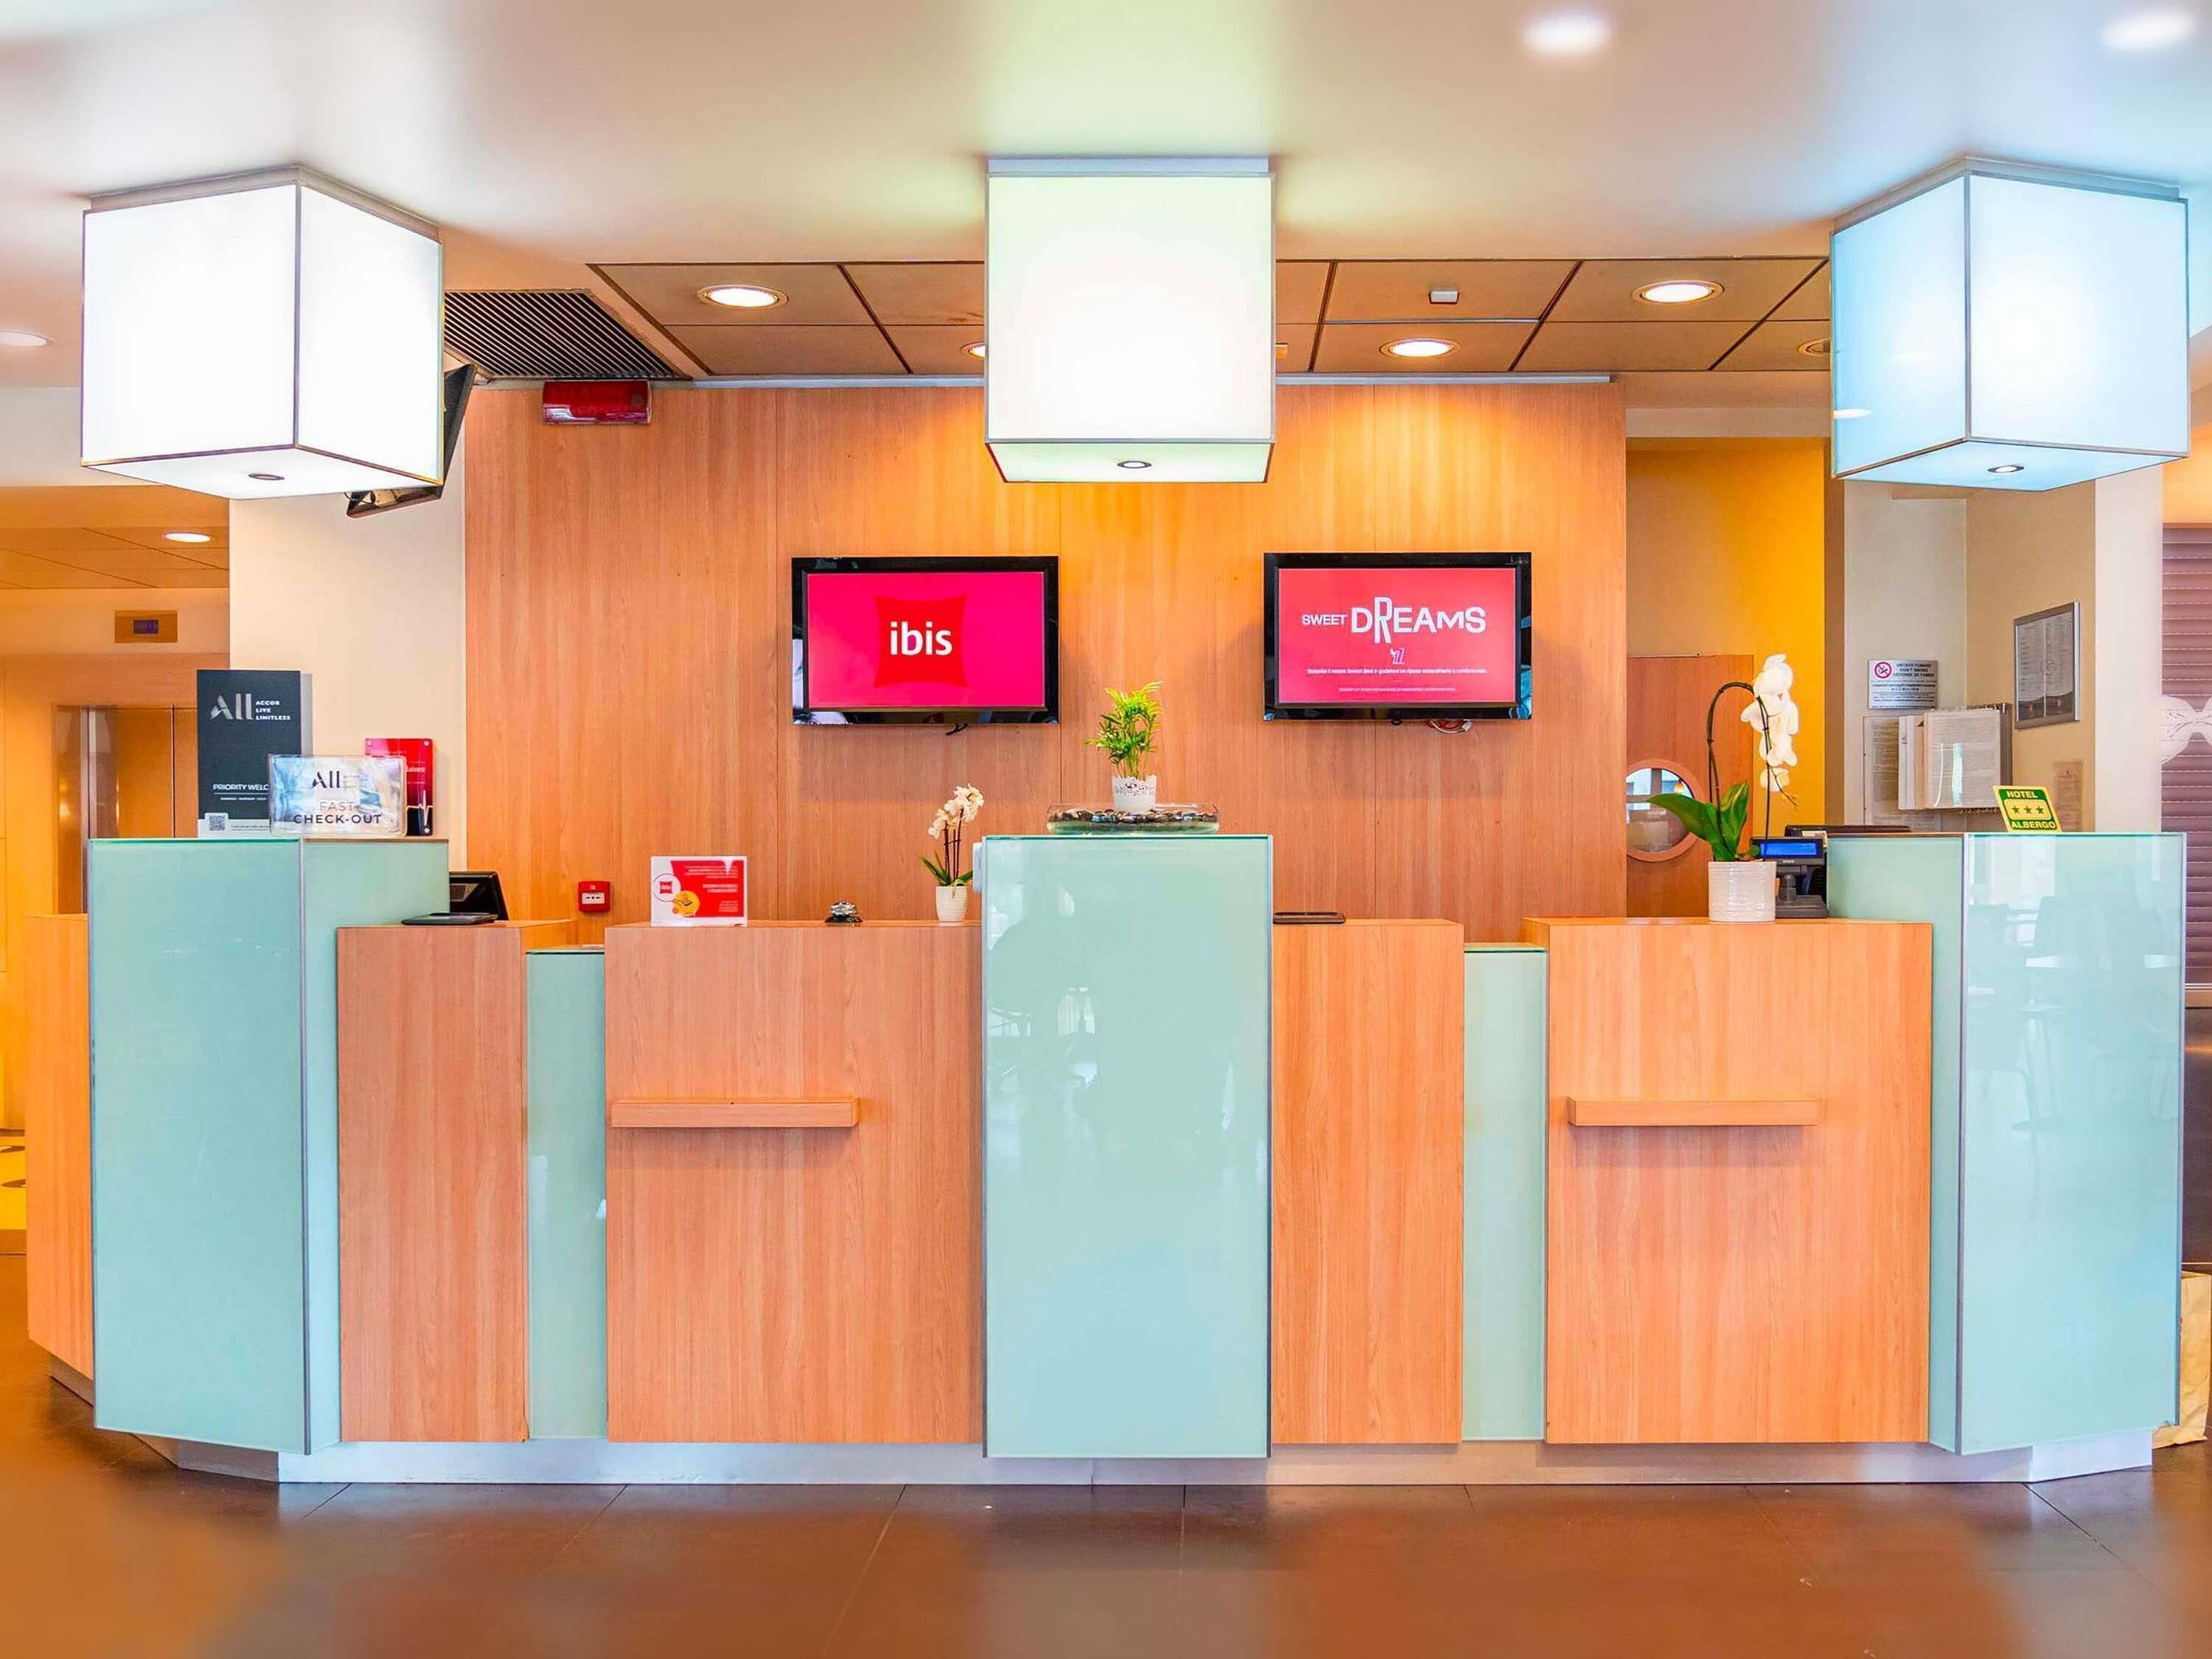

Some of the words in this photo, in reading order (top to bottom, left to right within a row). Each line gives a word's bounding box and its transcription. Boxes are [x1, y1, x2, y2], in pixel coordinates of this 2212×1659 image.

[1302, 613, 1347, 626] SWEET
[1351, 597, 1486, 644] DREAMS
[890, 621, 953, 655] ibis
[2006, 790, 2039, 799] HOTEL
[319, 801, 355, 811] FAST
[293, 814, 382, 824] CHECK-OUT
